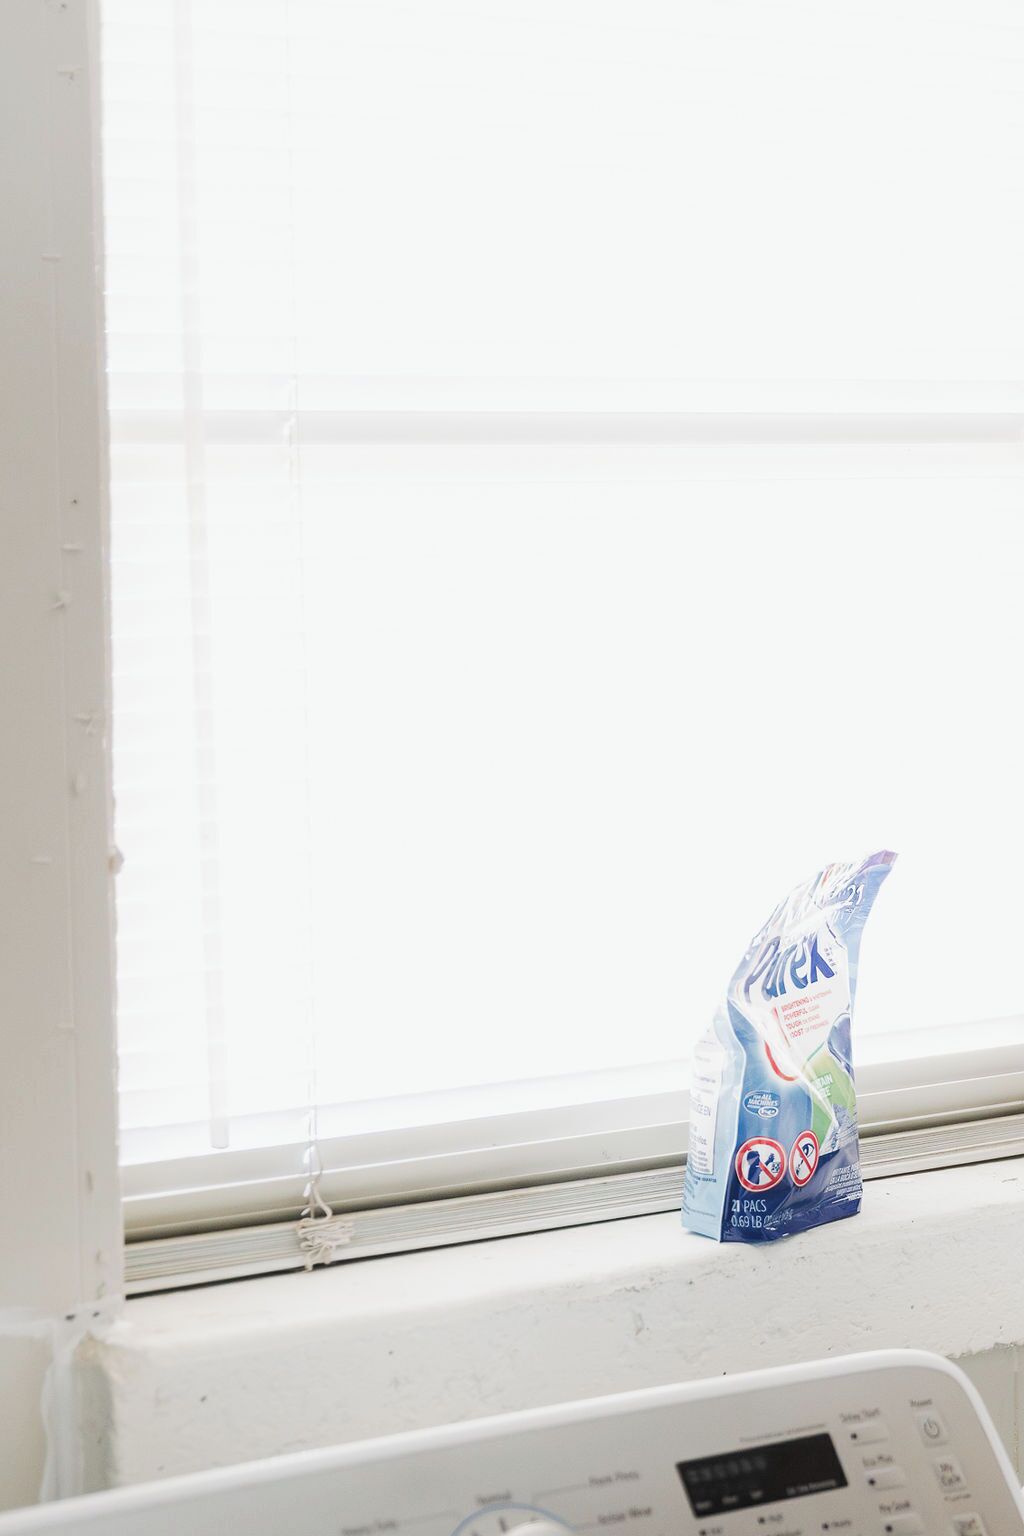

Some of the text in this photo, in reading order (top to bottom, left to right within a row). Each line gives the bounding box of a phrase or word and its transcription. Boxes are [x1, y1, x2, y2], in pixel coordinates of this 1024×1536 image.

[743, 933, 835, 1003] Purex
[731, 1199, 767, 1213] 21 PACS
[731, 1215, 749, 1228] 0.69
[751, 1215, 762, 1228] LB
